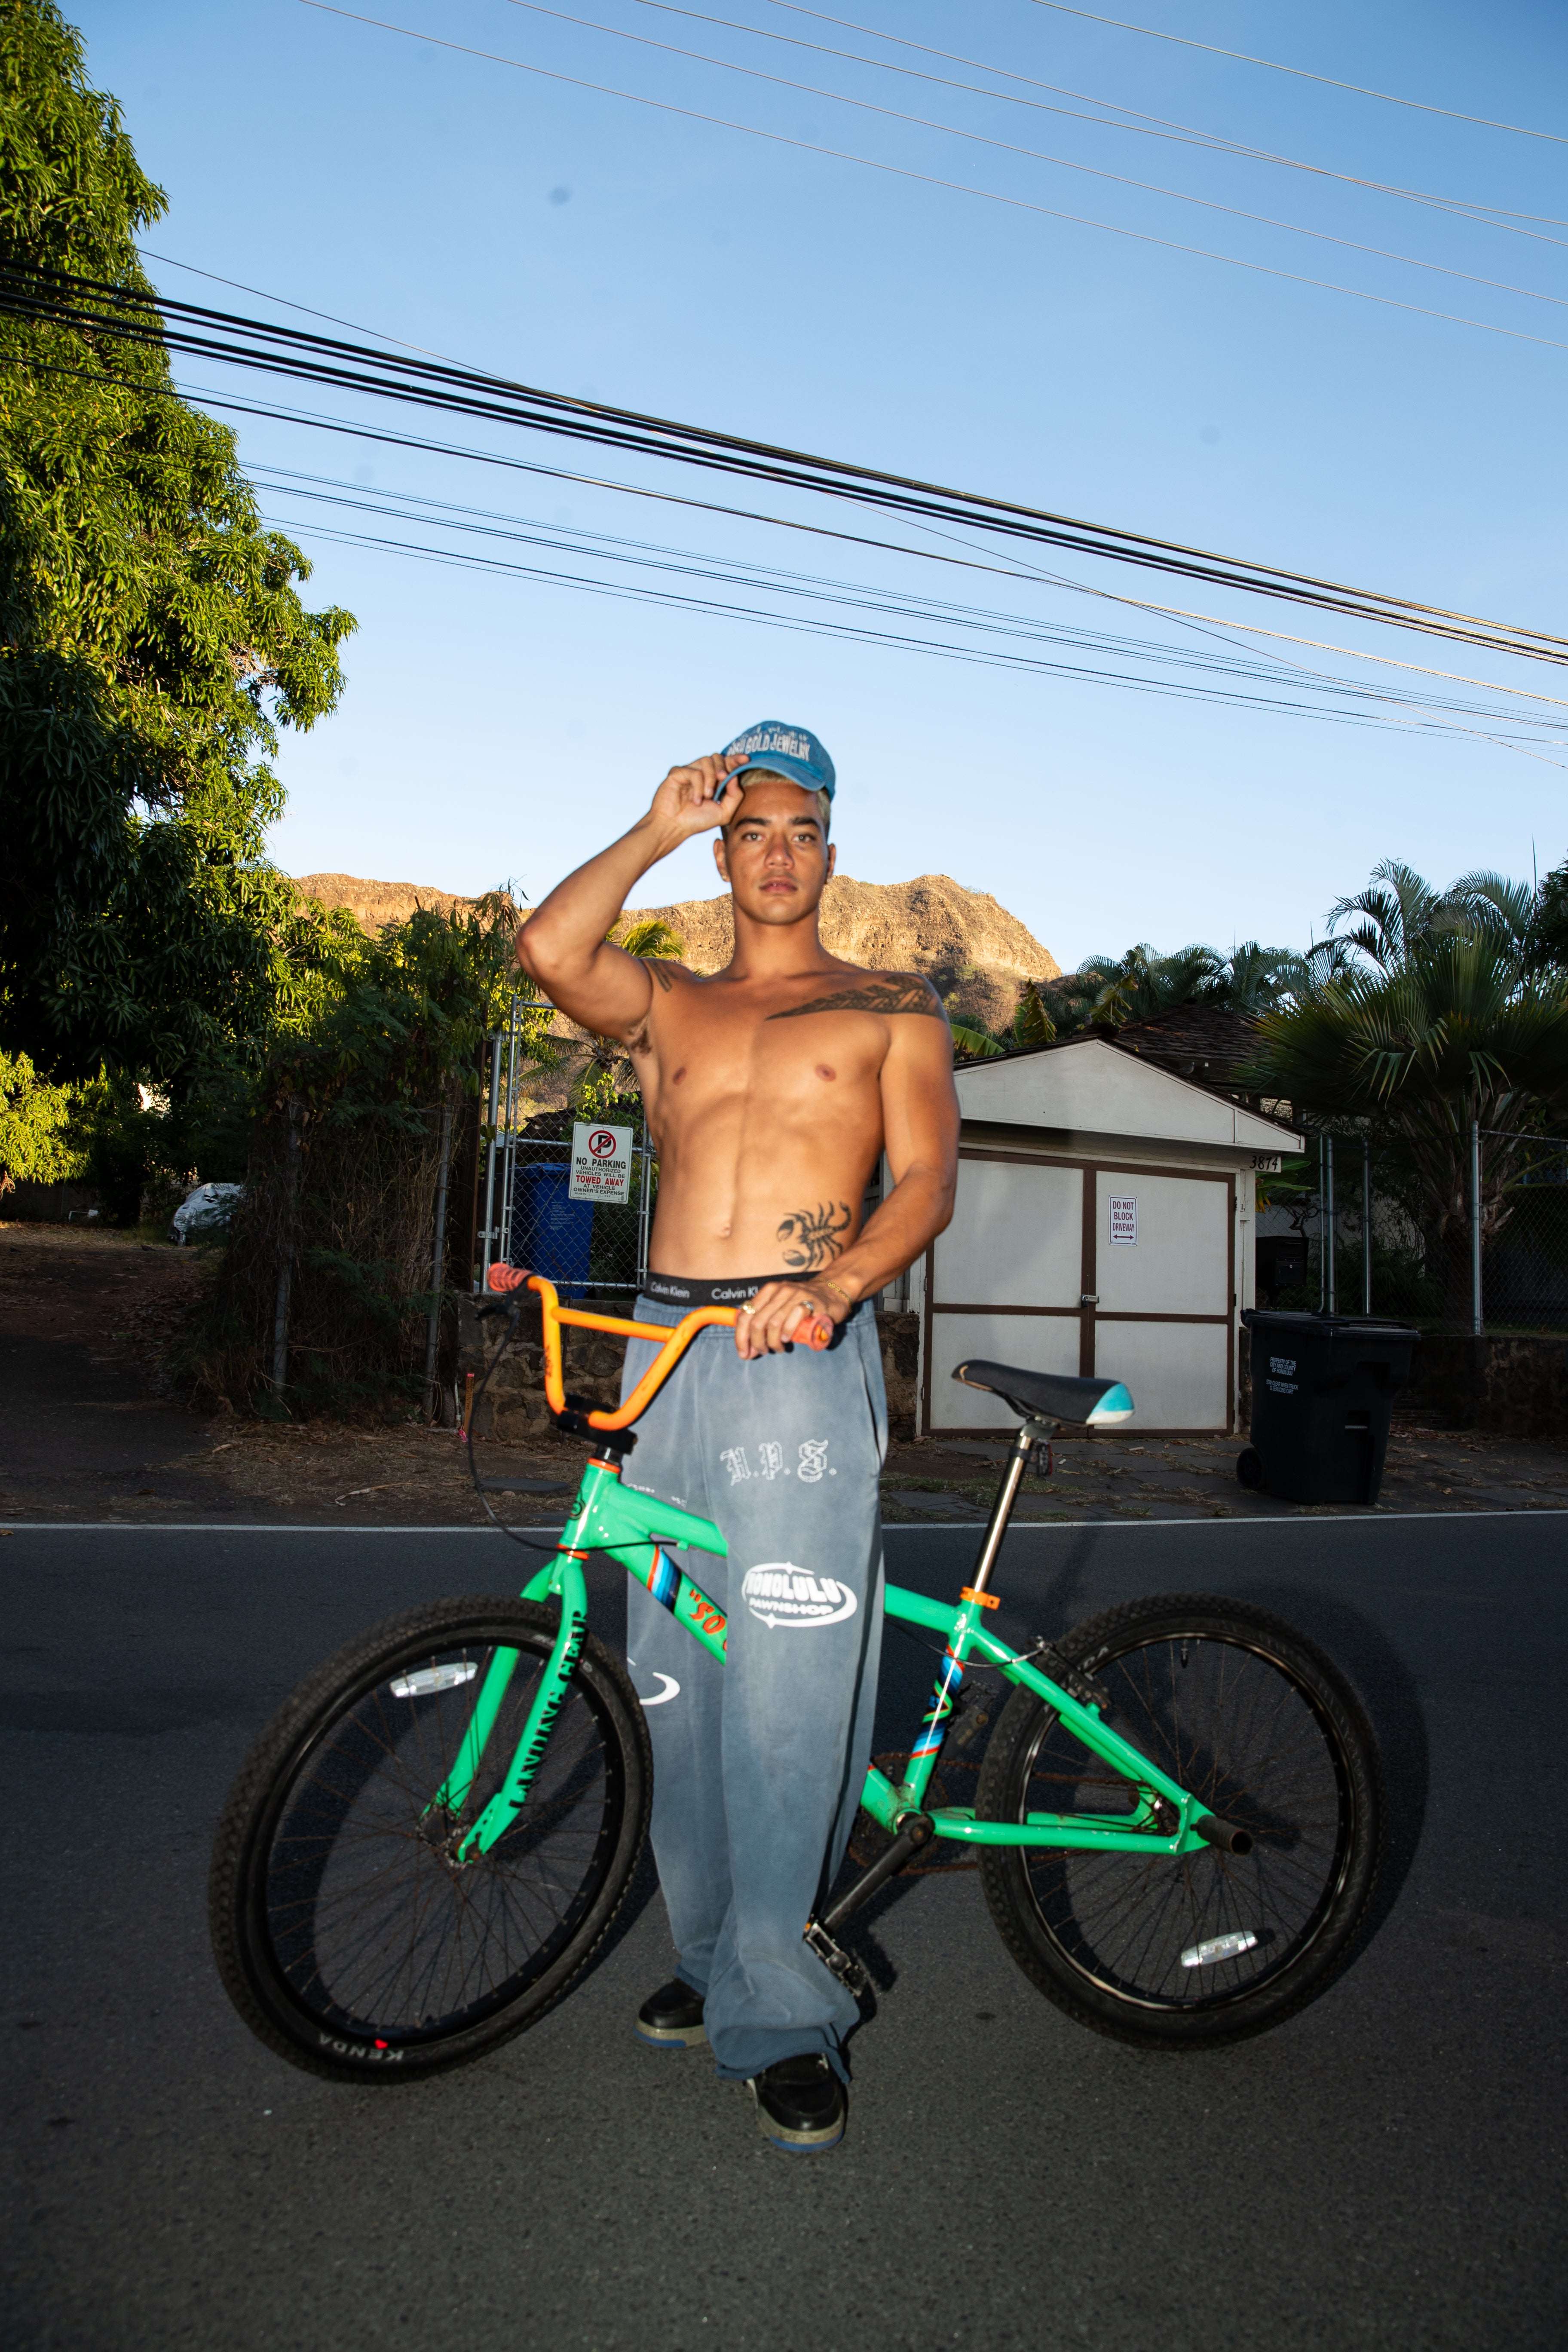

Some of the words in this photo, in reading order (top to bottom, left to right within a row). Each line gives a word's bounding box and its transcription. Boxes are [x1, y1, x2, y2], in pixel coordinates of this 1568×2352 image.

[745, 733, 770, 754] GOLD
[770, 734, 810, 762] JEWELRY
[576, 1157, 587, 1165] NO
[592, 1158, 626, 1169] PARKING
[576, 1175, 601, 1184] TOWED
[605, 1178, 624, 1187] AWAY
[1113, 1201, 1121, 1209] DO
[1123, 1201, 1134, 1210] NOT
[1114, 1212, 1133, 1221] BLOCK
[1113, 1223, 1135, 1232] DRIVEWAY
[650, 1281, 670, 1295] Calvin
[669, 1285, 690, 1298] Klein
[711, 1286, 746, 1300] Calvin
[746, 1572, 842, 1603] HONOLULU
[749, 1597, 834, 1615] PAWNSHOP
[318, 2032, 404, 2061] KENDA
